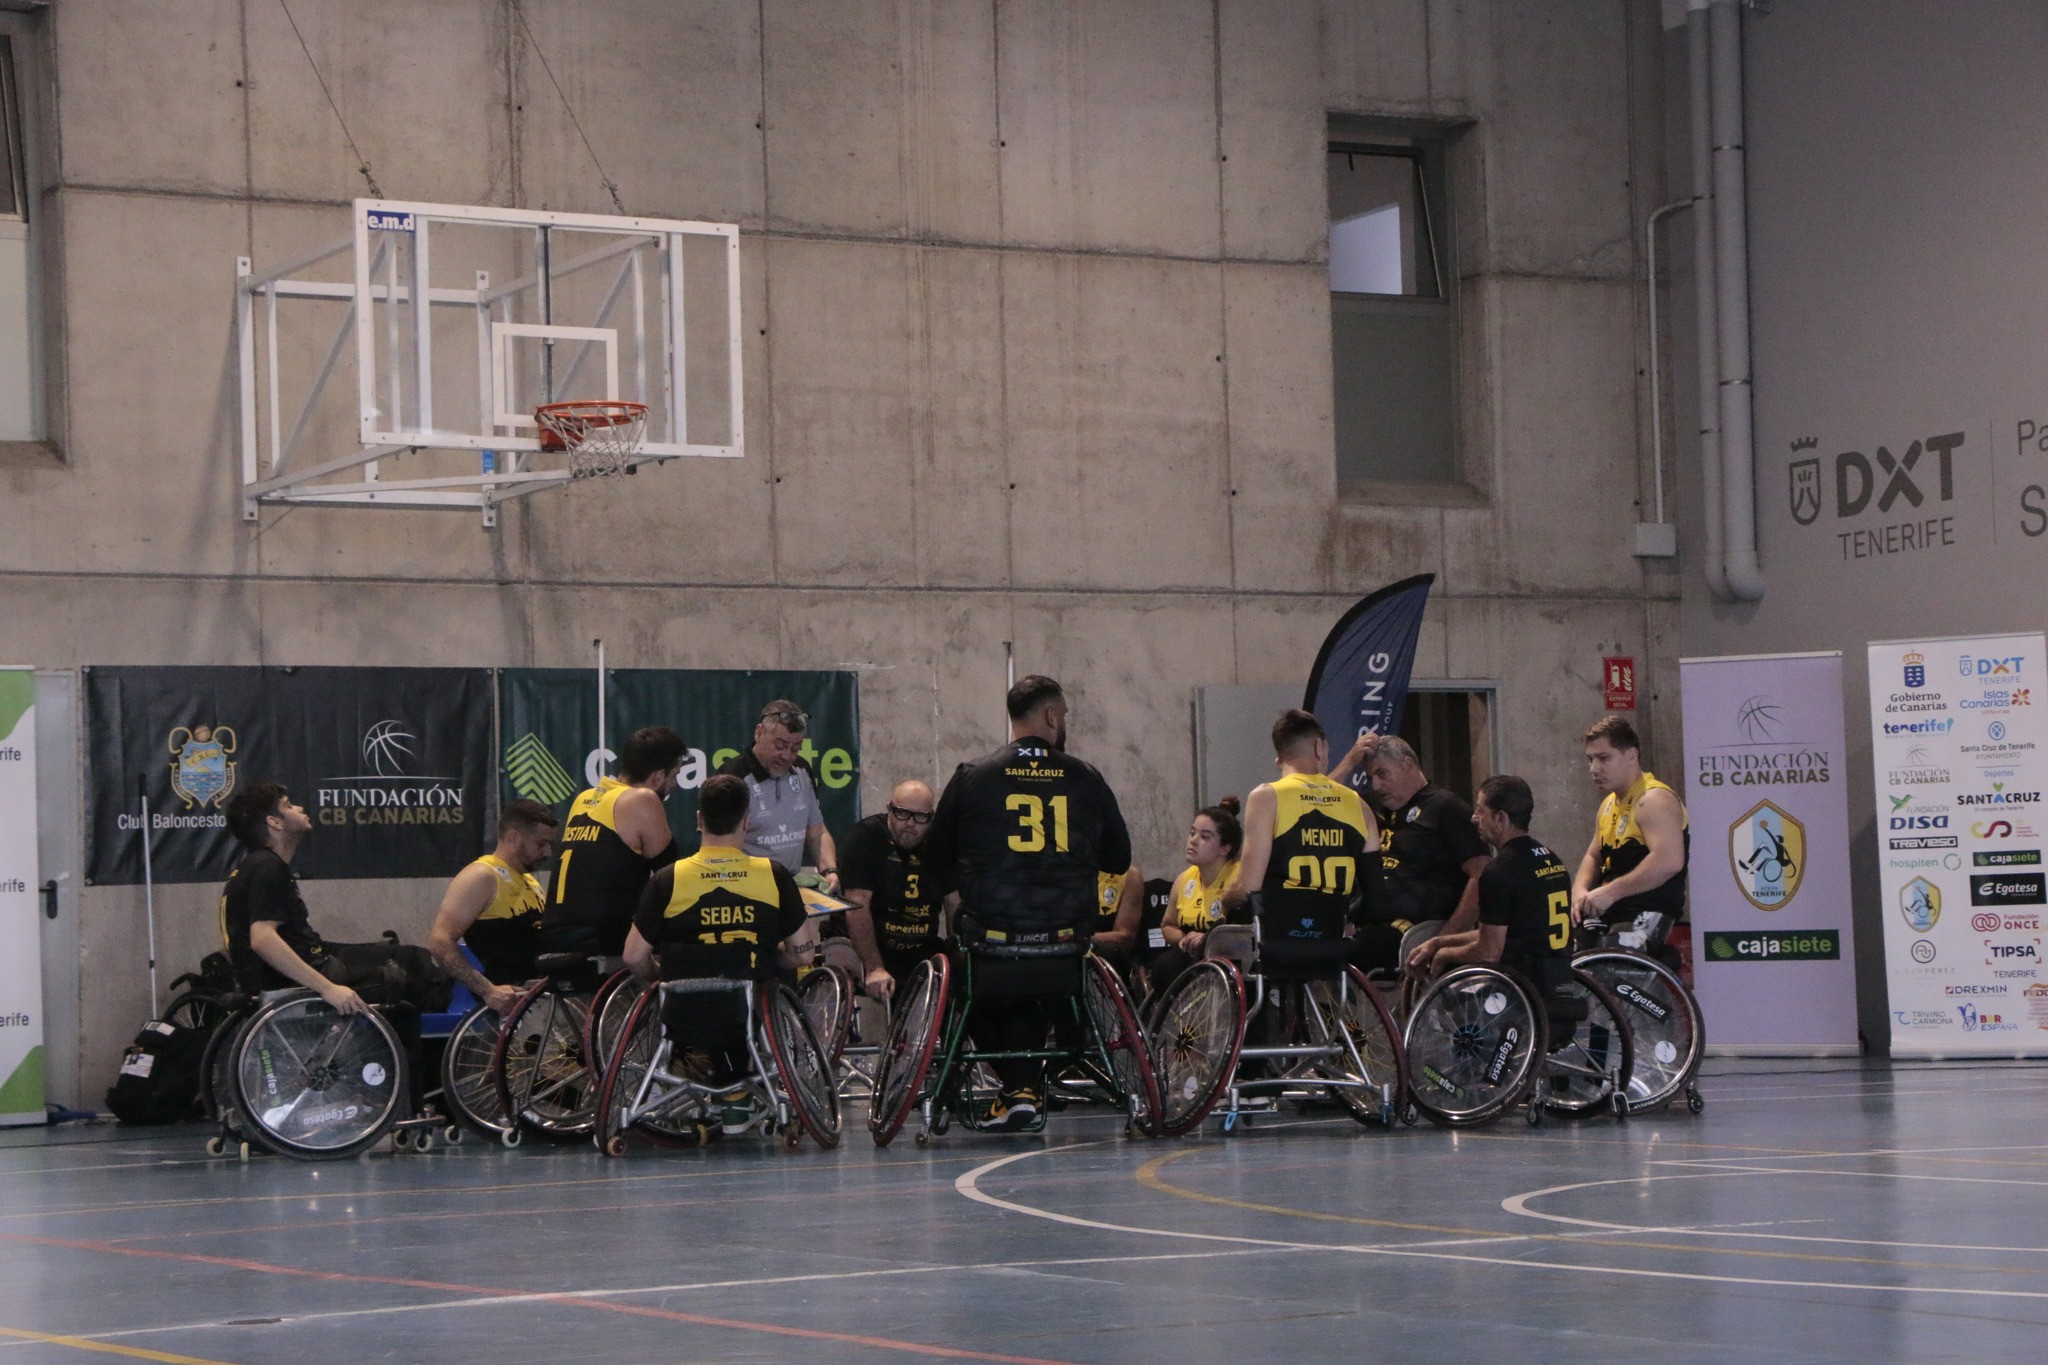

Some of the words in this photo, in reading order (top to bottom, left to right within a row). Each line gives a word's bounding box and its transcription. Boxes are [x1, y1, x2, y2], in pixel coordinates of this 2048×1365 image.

[368, 213, 415, 231] e.m.d
[1835, 431, 1965, 518] DXT
[1838, 517, 1955, 560] TENERIFE
[1977, 656, 2025, 675] DXT
[1979, 675, 2021, 685] TENERIFE
[1890, 692, 1941, 702] Gobierno
[1984, 690, 2009, 699] Islas
[1885, 704, 1899, 713] de
[1900, 702, 1948, 712] Canarias
[1960, 699, 2010, 709] Canarias
[1999, 743, 2007, 751] de
[2008, 742, 2036, 750] Tenerife
[1699, 749, 1829, 771] FUNDACIÓN
[1976, 752, 2022, 760] AYUNTAMIENTO
[1005, 768, 1064, 777] SANTACRUZ
[1699, 772, 1724, 786] CB
[1730, 768, 1830, 785] CANARIAS
[1889, 768, 1950, 778] FUNDACIÓN
[1984, 770, 2015, 778] Deportes
[1904, 776, 1951, 784] CANARIAS
[318, 783, 463, 806] FUNDACIÓN
[1300, 795, 1341, 803] SANTACRUZ
[1957, 792, 2041, 805] SANTACRUZ
[318, 808, 347, 825] CB
[354, 806, 464, 825] CANARIAS
[1906, 805, 1950, 813] FUNDACIÓN
[152, 813, 227, 829] Baloncesto
[1005, 794, 1069, 852] 31
[1301, 828, 1344, 847] MENDI
[1890, 860, 1939, 869] hospiten
[1989, 853, 2038, 864] cajasiete
[701, 871, 748, 879] SANTACRUZ
[905, 874, 919, 899] 3
[1995, 883, 2038, 896] Egatesa
[701, 906, 755, 925] SEBAS
[1548, 890, 1570, 950] 5
[2004, 921, 2039, 929] ONCE
[1017, 934, 1047, 942] LINCE
[1737, 936, 1832, 957] cajasiete
[1991, 945, 2036, 957] TIPSA
[1993, 970, 2037, 978] TENERIFE
[1955, 985, 2007, 994] DREXMIN
[1630, 990, 1666, 1016] Egatesa
[1490, 1041, 1514, 1080] Egatesa
[261, 1049, 277, 1095] cajasiete
[1423, 1065, 1456, 1093] cajasiete
[303, 1108, 343, 1125] Egatesa
